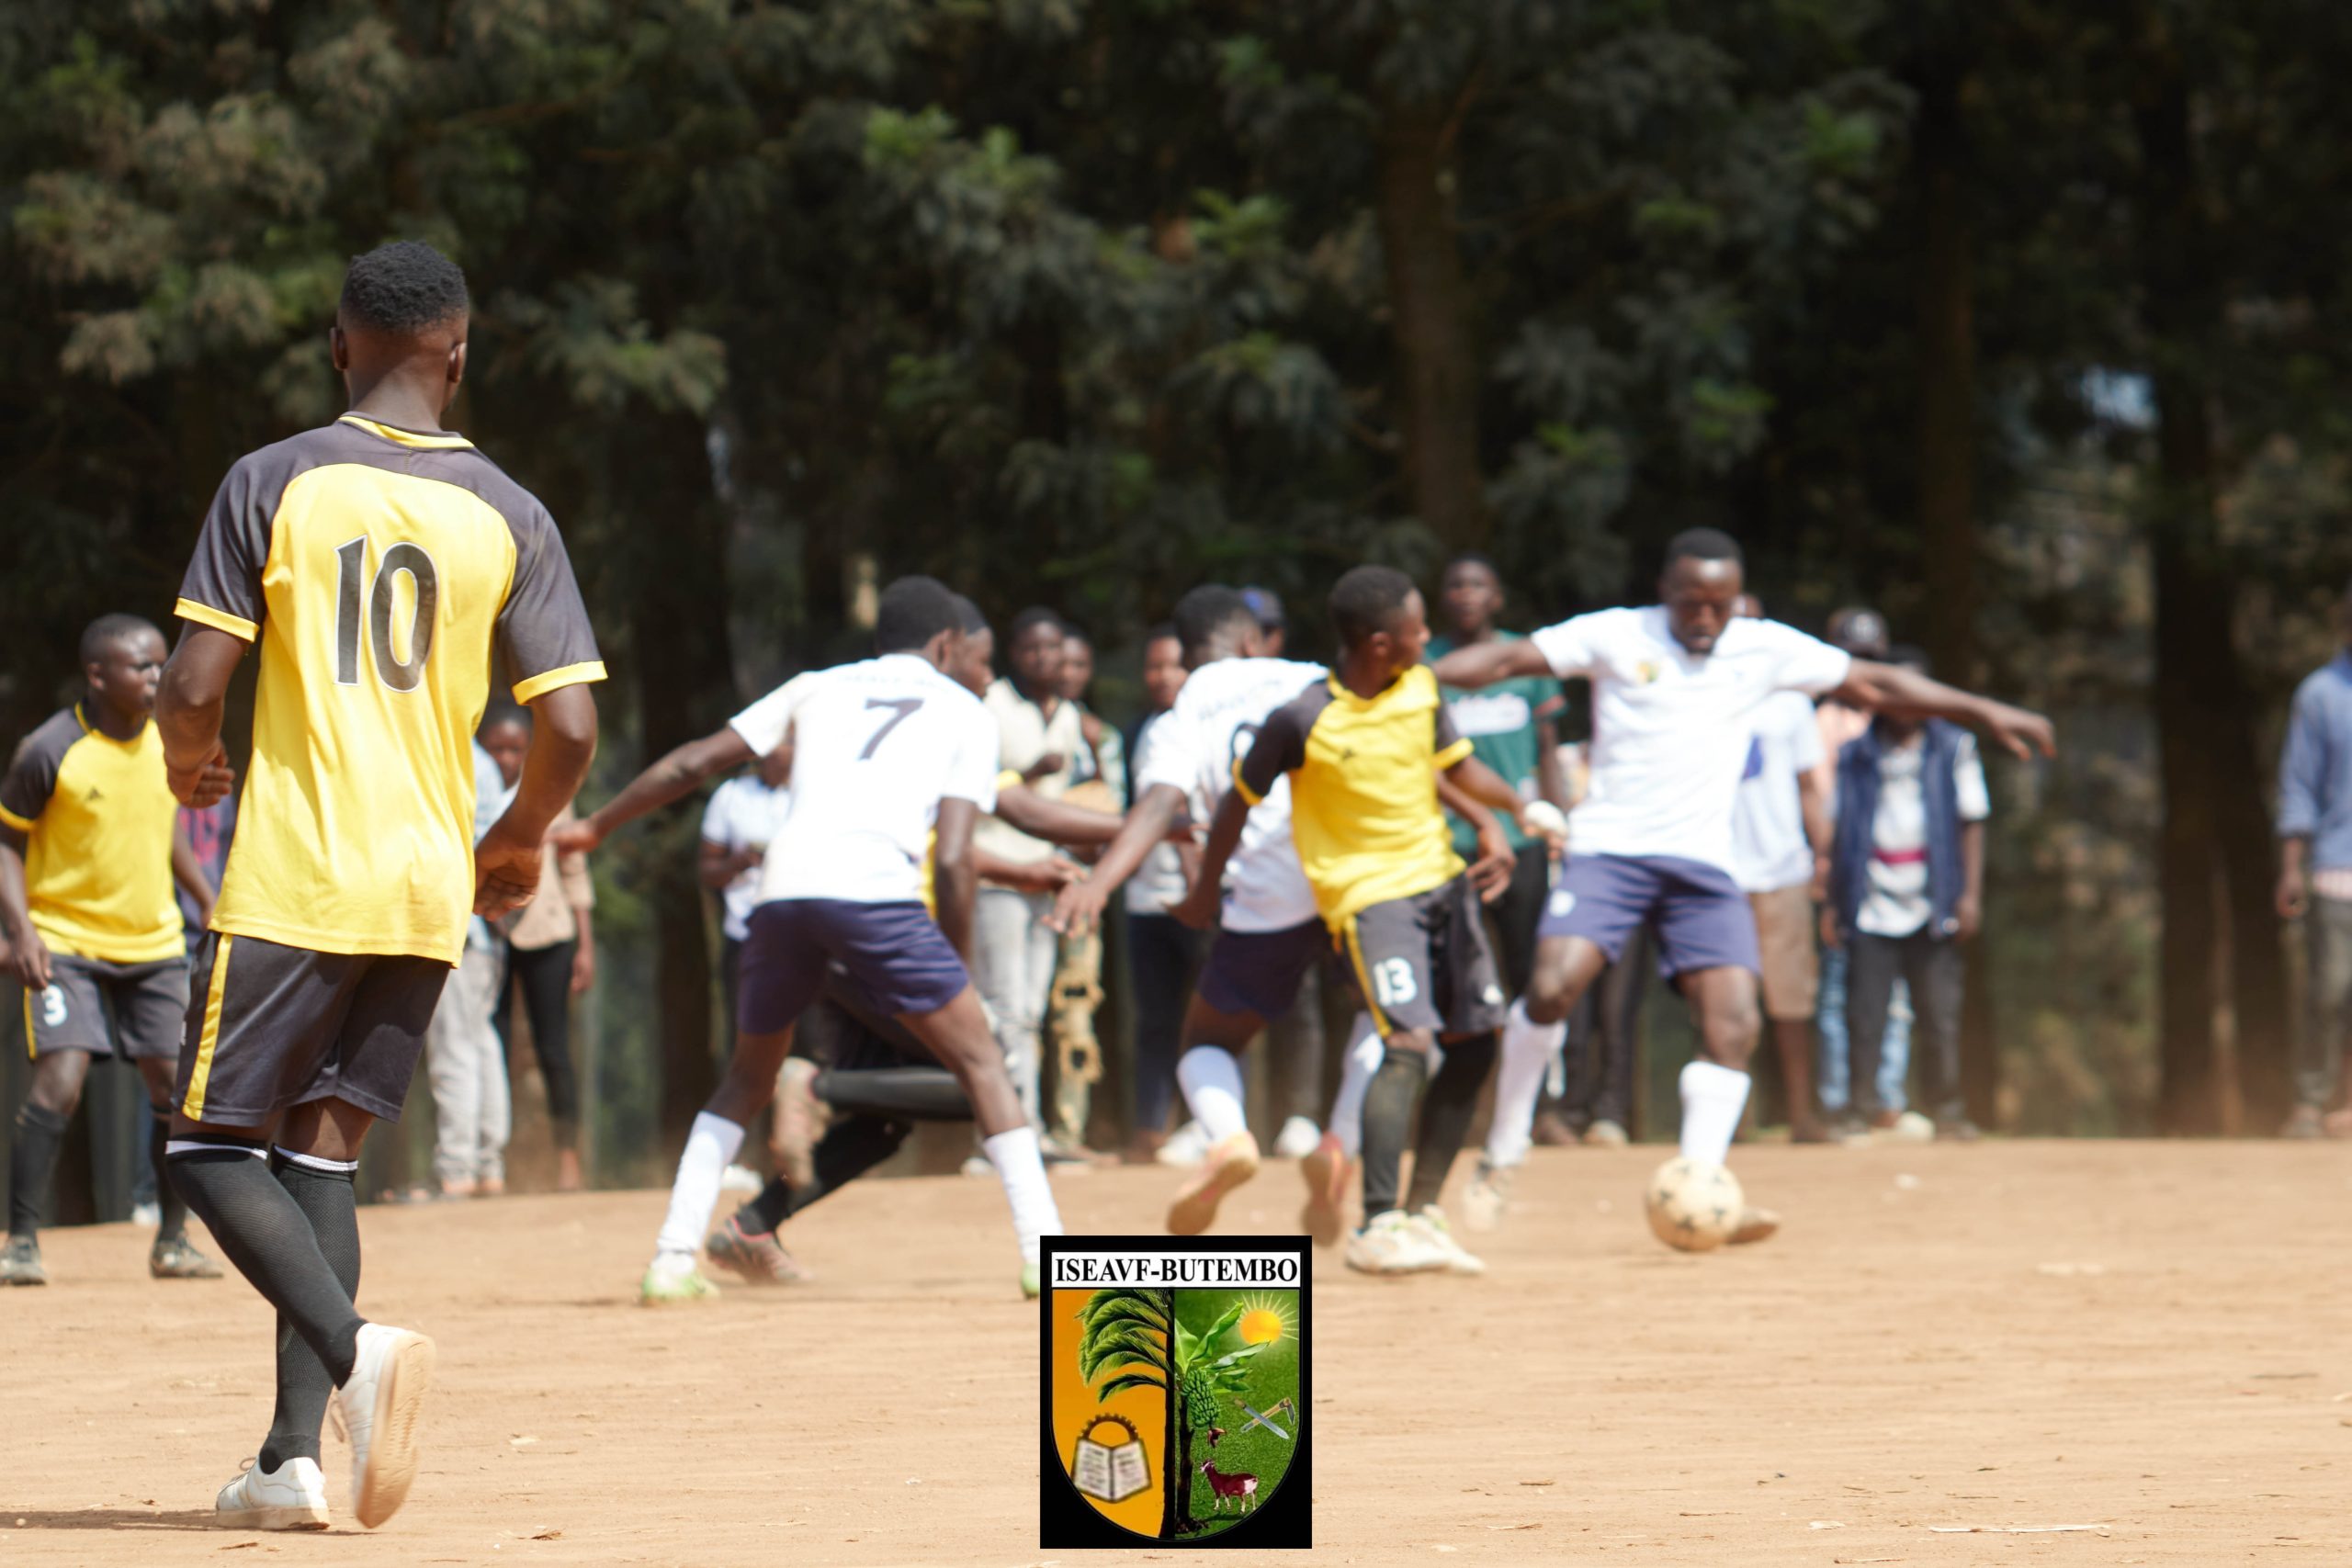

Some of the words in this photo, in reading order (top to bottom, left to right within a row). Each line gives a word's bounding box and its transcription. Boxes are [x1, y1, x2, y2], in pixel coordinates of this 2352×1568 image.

[334, 534, 440, 693] 10
[858, 697, 925, 761] 7
[40, 984, 68, 1027] 3
[1373, 956, 1418, 1007] 13
